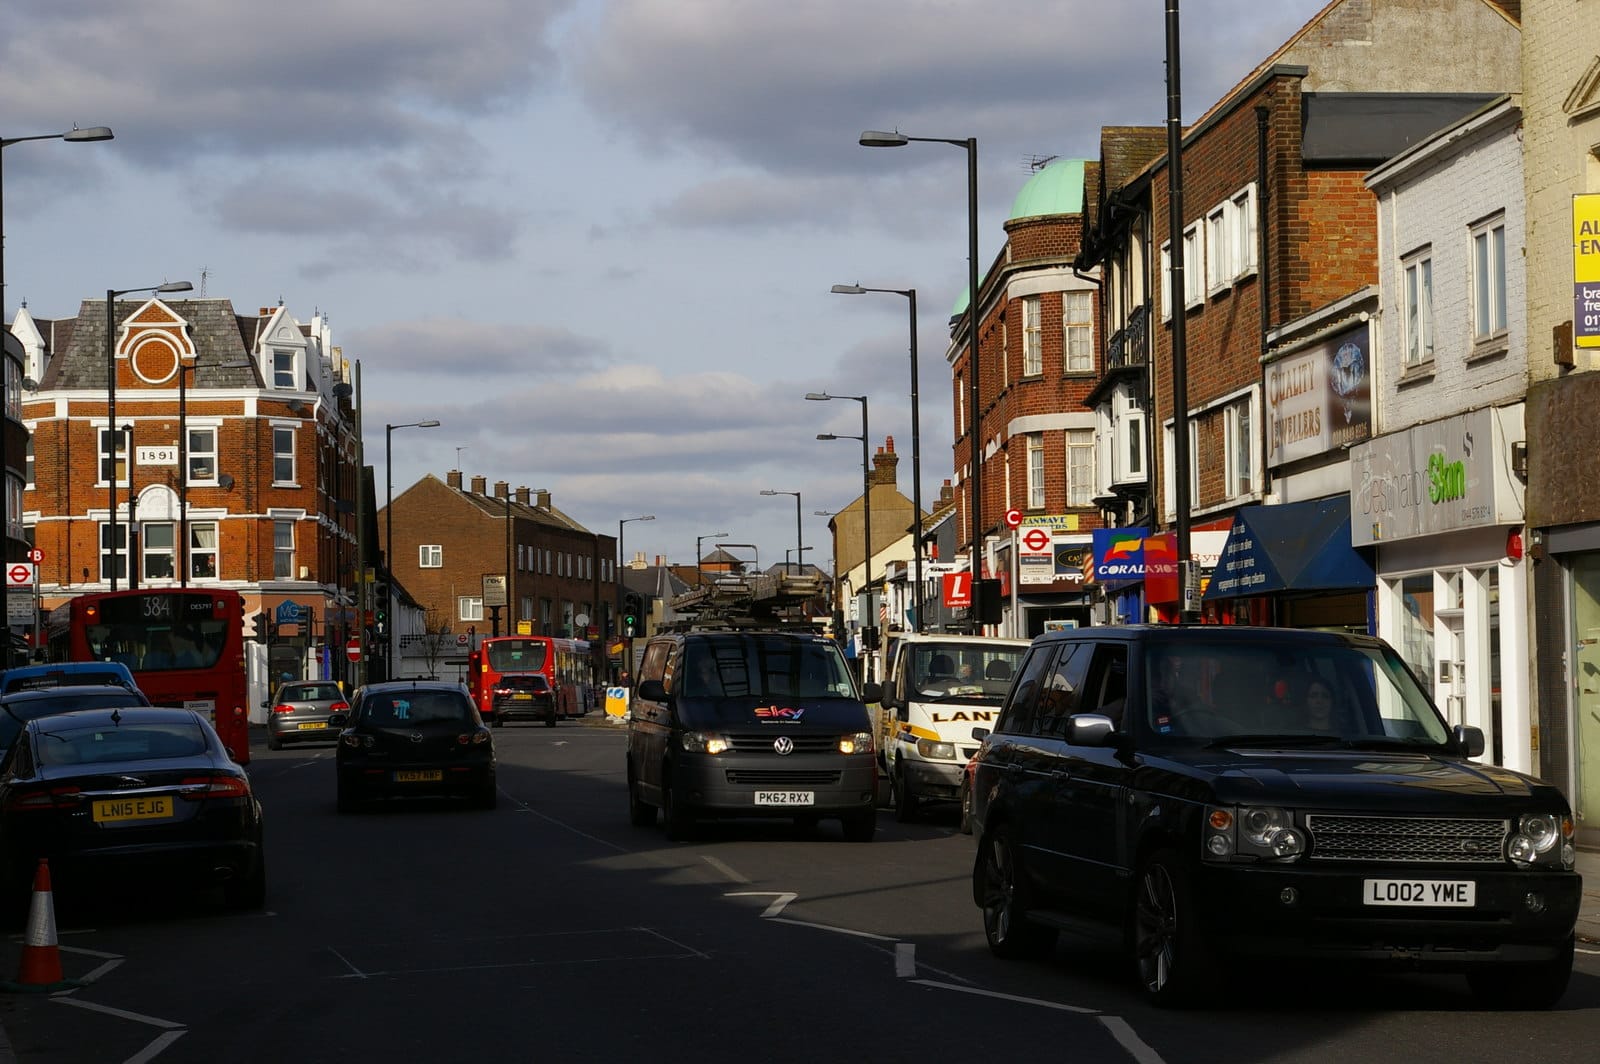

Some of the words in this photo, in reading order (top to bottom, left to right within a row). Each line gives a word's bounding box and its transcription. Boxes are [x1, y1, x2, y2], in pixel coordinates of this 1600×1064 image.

[1270, 361, 1314, 409] QUALITY
[1270, 407, 1321, 458] JEWELLERS
[141, 451, 173, 460] 1891
[1427, 452, 1465, 505] Skin
[1006, 510, 1020, 524] C
[1098, 564, 1145, 575] CORAL
[952, 576, 965, 598] L
[143, 596, 170, 617] 384
[753, 705, 805, 720] sky
[759, 793, 786, 803] PK62
[789, 793, 809, 803] RXX
[102, 803, 133, 816] LN15
[137, 801, 164, 814] EJG
[1373, 882, 1424, 901] LO02
[1431, 884, 1468, 902] YME
